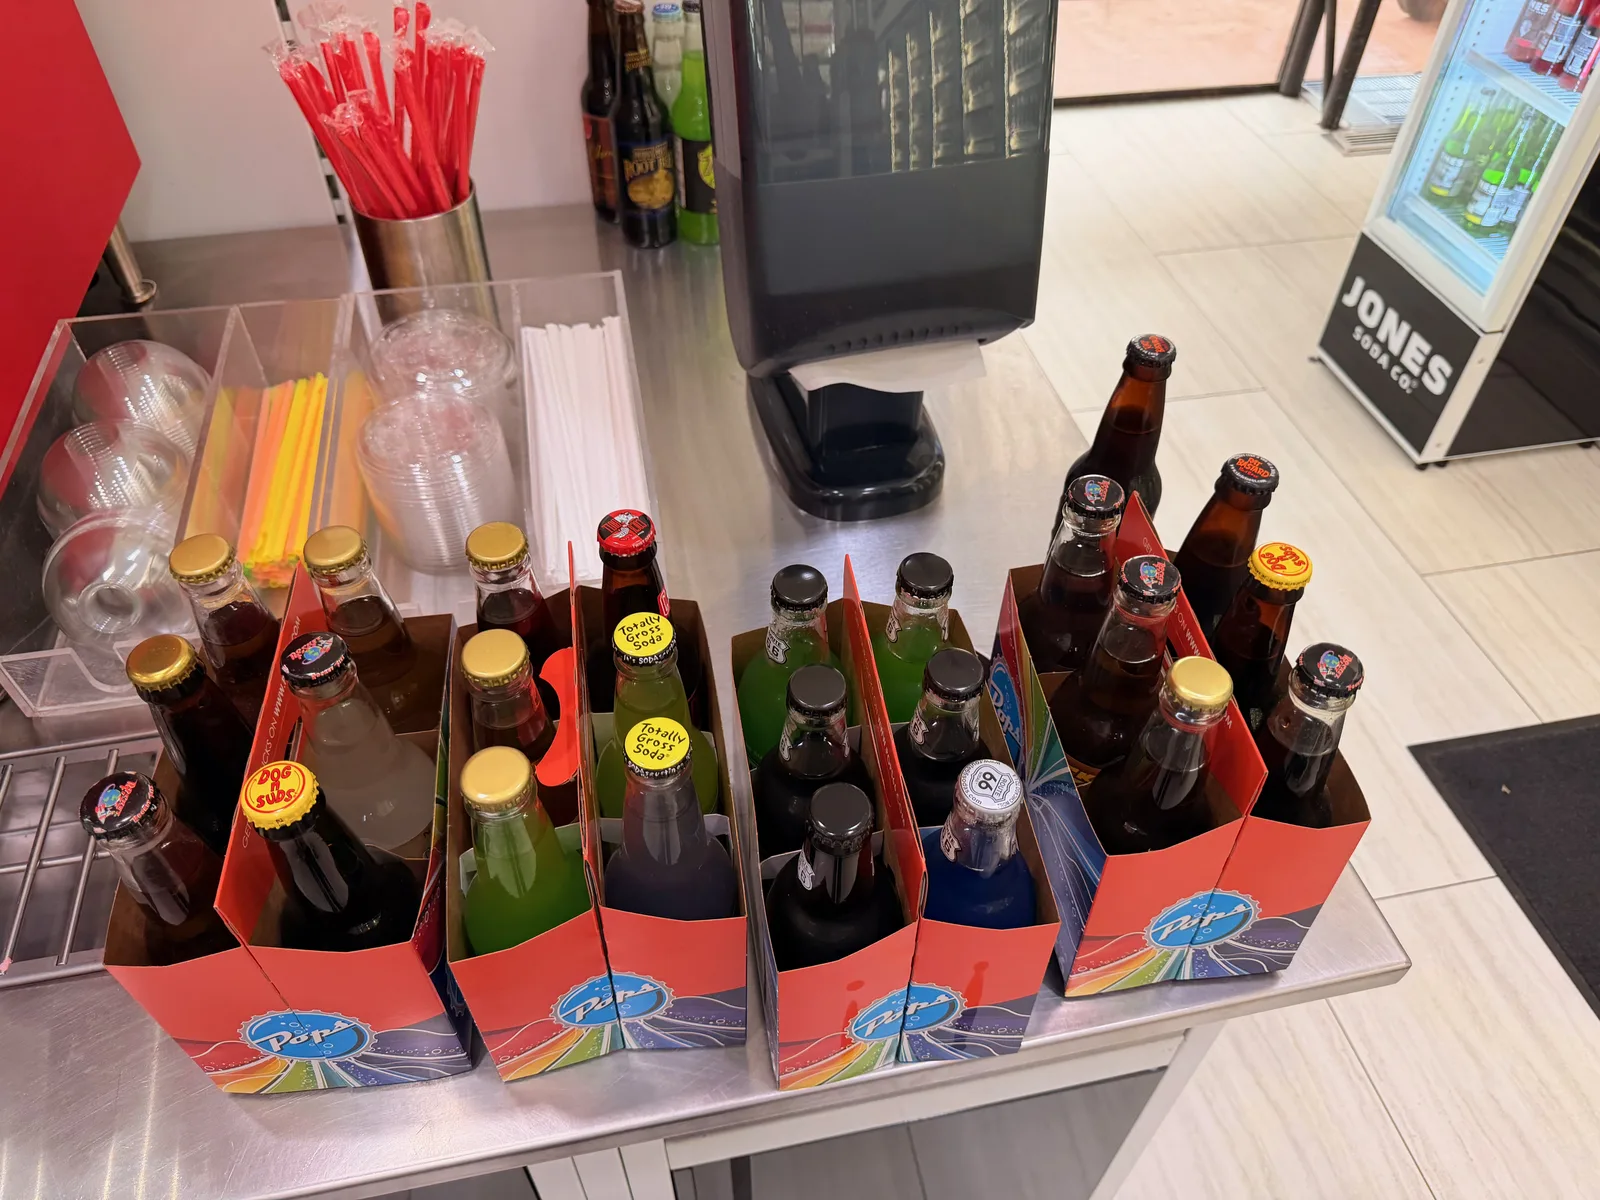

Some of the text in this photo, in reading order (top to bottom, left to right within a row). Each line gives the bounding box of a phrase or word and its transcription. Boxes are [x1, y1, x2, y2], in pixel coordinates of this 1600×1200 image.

[1342, 276, 1453, 395] JONES
[1352, 325, 1390, 370] SODA
[1236, 458, 1270, 478] BASTARD
[1247, 457, 1263, 467] RAT
[1261, 552, 1287, 570] DOG
[618, 616, 660, 635] Totally
[626, 625, 660, 642] Gross
[633, 635, 662, 650] Soda
[261, 739, 273, 766] ICKS
[268, 718, 278, 736] ON
[637, 733, 675, 751] Gross
[641, 723, 686, 744] Totally
[633, 744, 665, 760] Soda
[258, 766, 292, 785] DOG
[978, 771, 998, 792] 66
[994, 777, 1008, 798] ROUTE
[256, 788, 296, 809] SUDS
[1151, 903, 1252, 942] Pops
[560, 983, 660, 1023] Pops
[853, 994, 957, 1037] Pops
[253, 1020, 357, 1052] Pops
